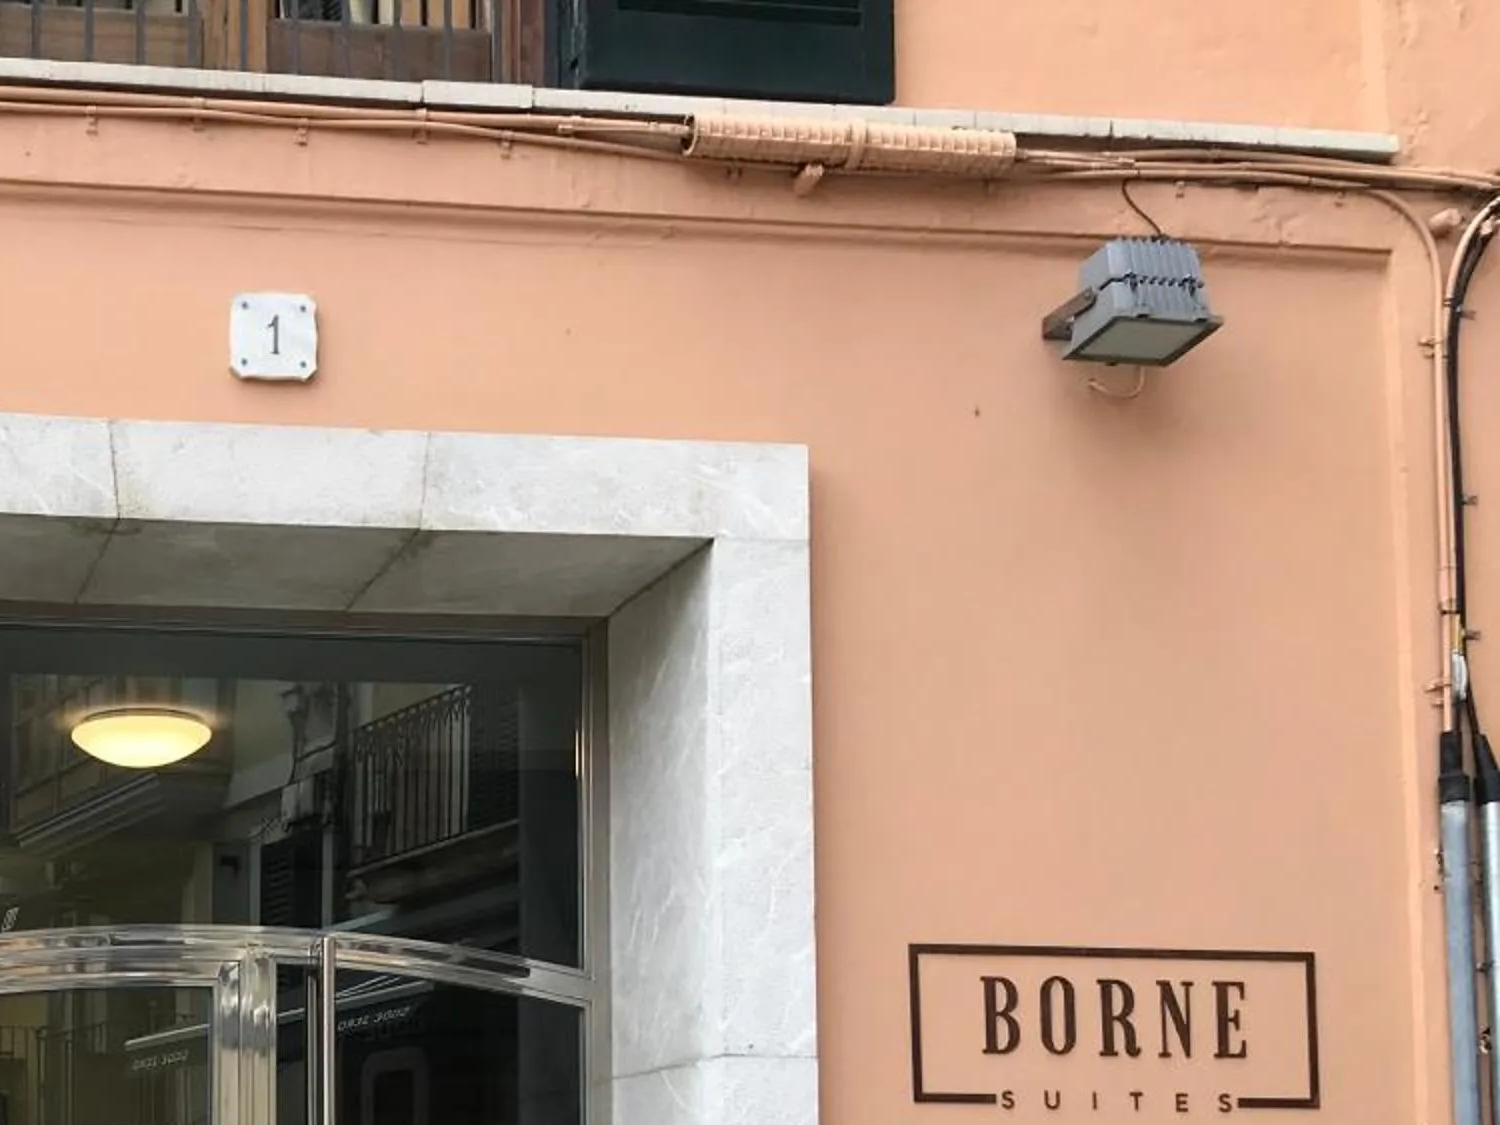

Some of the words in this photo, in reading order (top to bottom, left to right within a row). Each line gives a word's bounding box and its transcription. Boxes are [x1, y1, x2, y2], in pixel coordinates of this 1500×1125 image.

[267, 313, 280, 355] 1
[980, 976, 1247, 1059] BORNE
[1001, 1090, 1233, 1113] SUITES
